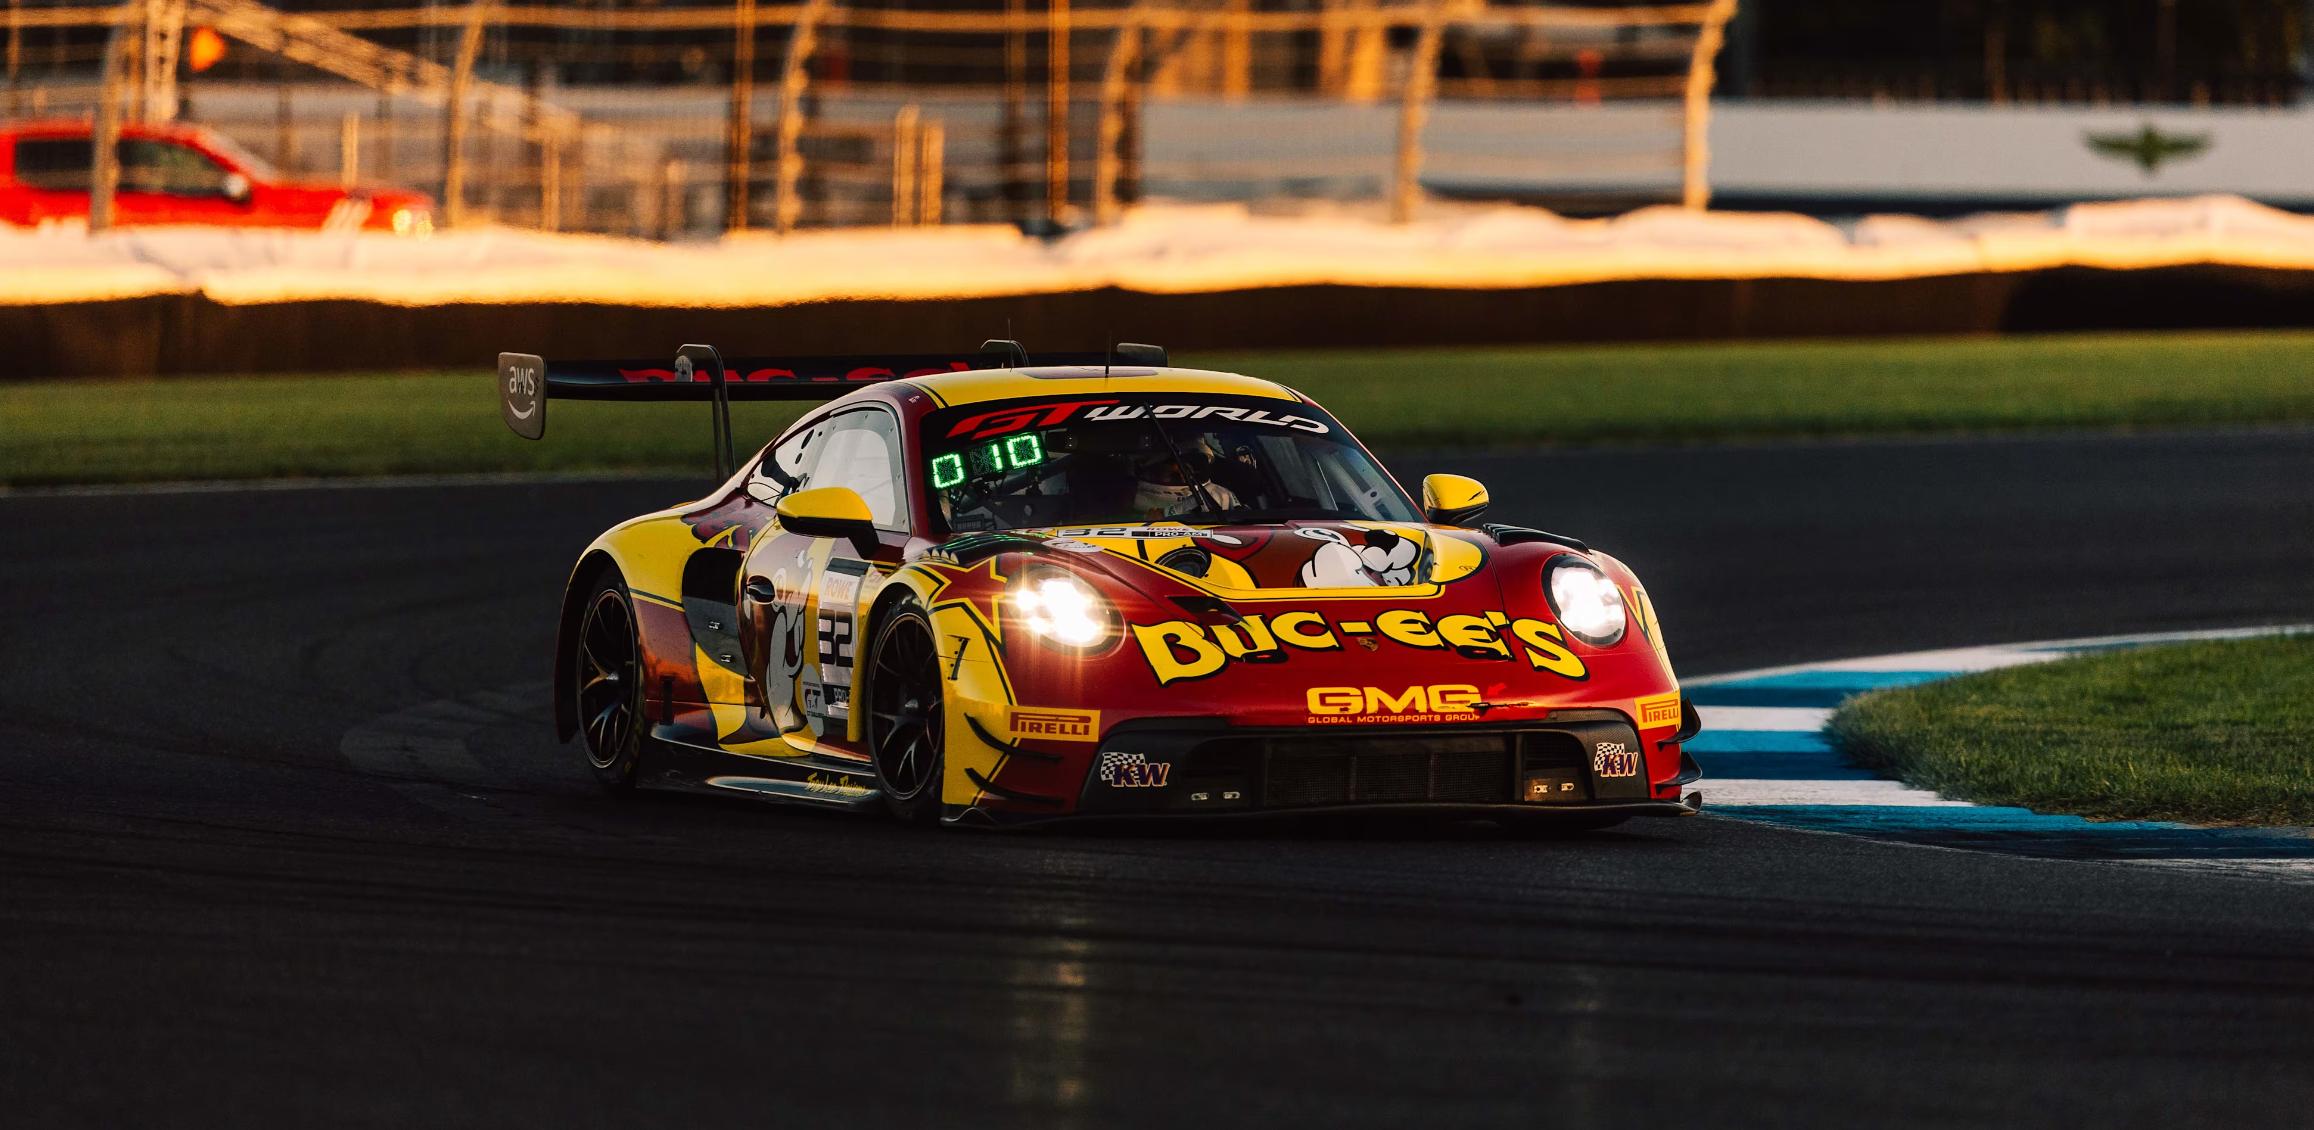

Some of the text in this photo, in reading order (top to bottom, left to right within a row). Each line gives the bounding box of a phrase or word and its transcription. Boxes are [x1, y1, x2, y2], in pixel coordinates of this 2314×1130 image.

[508, 366, 536, 397] aws
[945, 399, 1330, 440] GT WORLD
[818, 608, 854, 668] 32
[1305, 684, 1482, 715] GMG
[1640, 699, 1679, 723] PIRELLI
[1009, 711, 1092, 736] PIRELLI
[1307, 716, 1352, 724] GLOBAL
[1357, 714, 1441, 723] MOTORSPORTS
[1111, 762, 1171, 788] KW
[1601, 752, 1639, 778] KW
